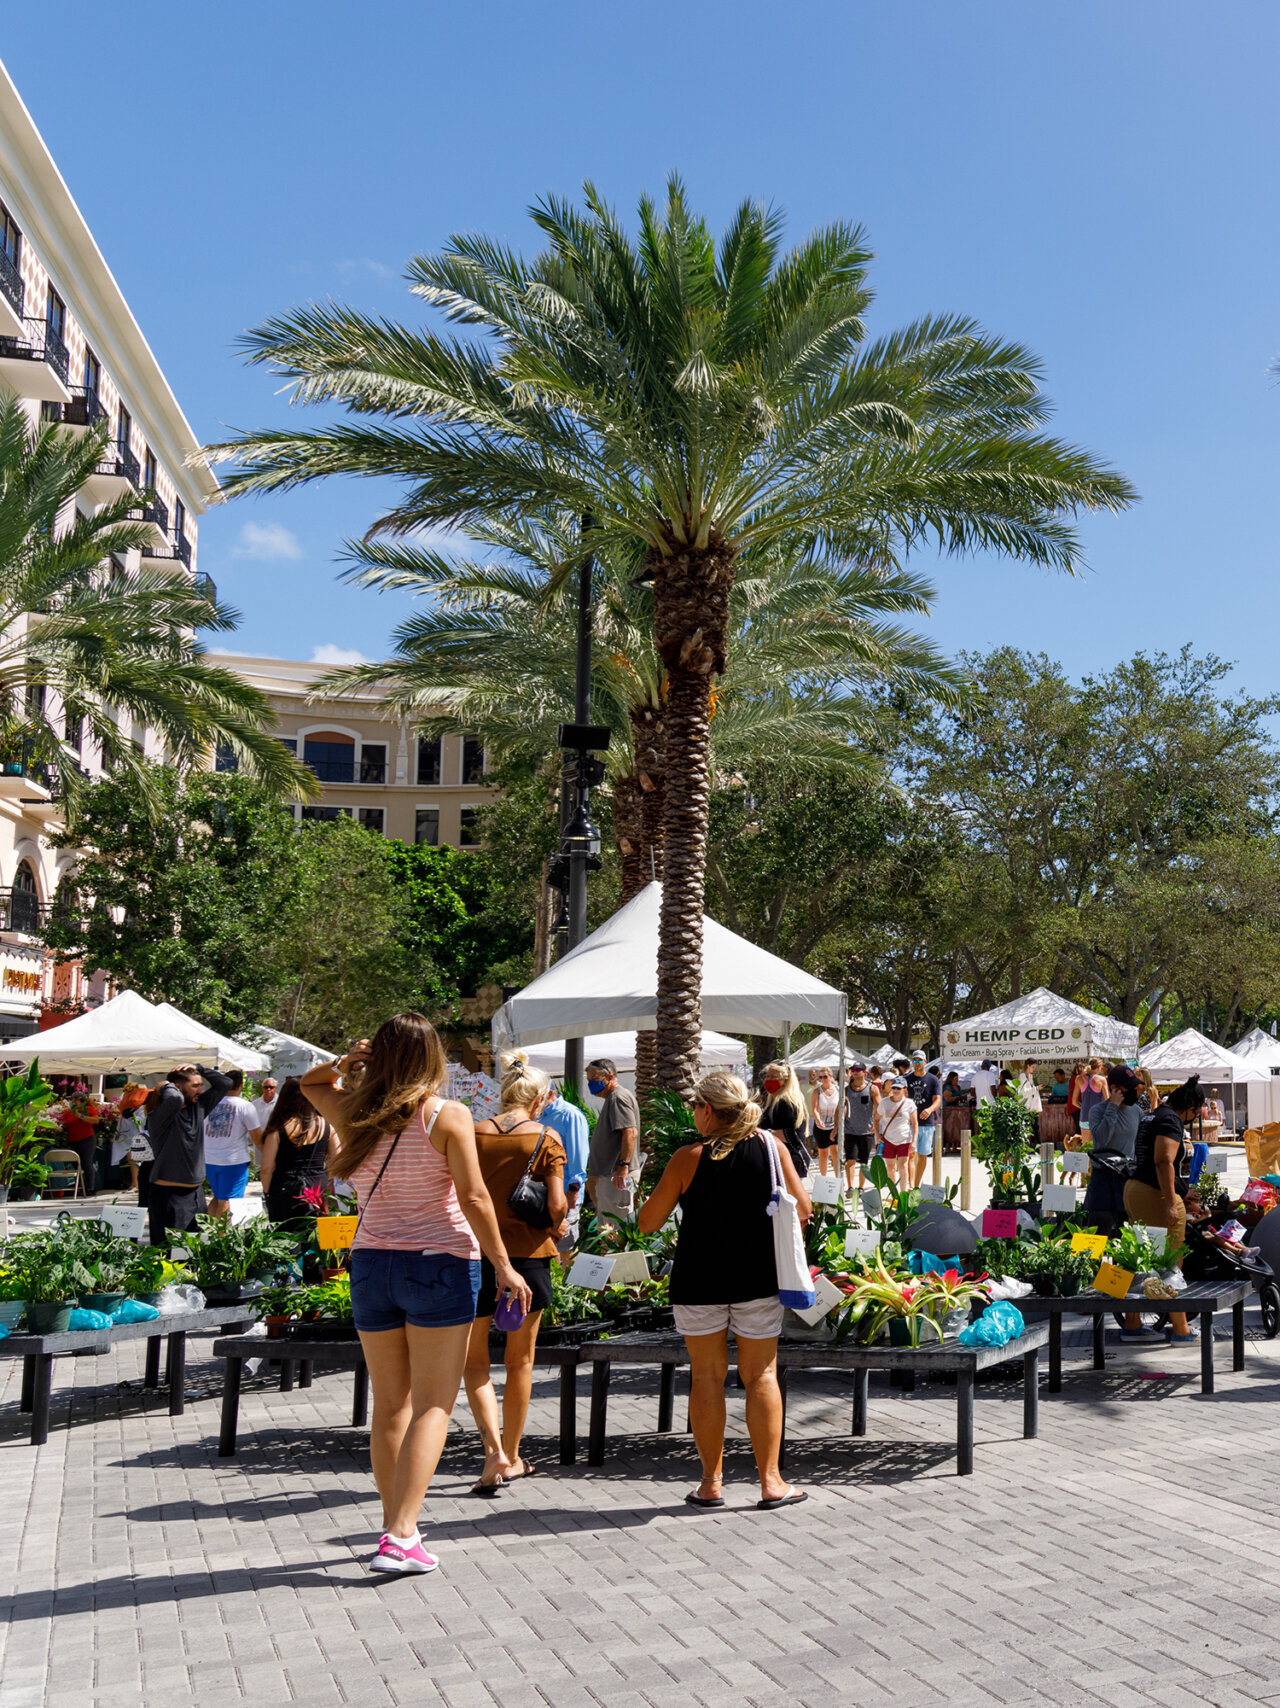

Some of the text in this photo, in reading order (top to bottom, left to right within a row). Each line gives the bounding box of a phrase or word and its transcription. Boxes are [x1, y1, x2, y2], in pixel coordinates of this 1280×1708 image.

[965, 1028, 1065, 1043] HEMP CBD
[950, 1044, 1080, 1058] Sun Cream Bug Spray Facial Line Dry Skin
